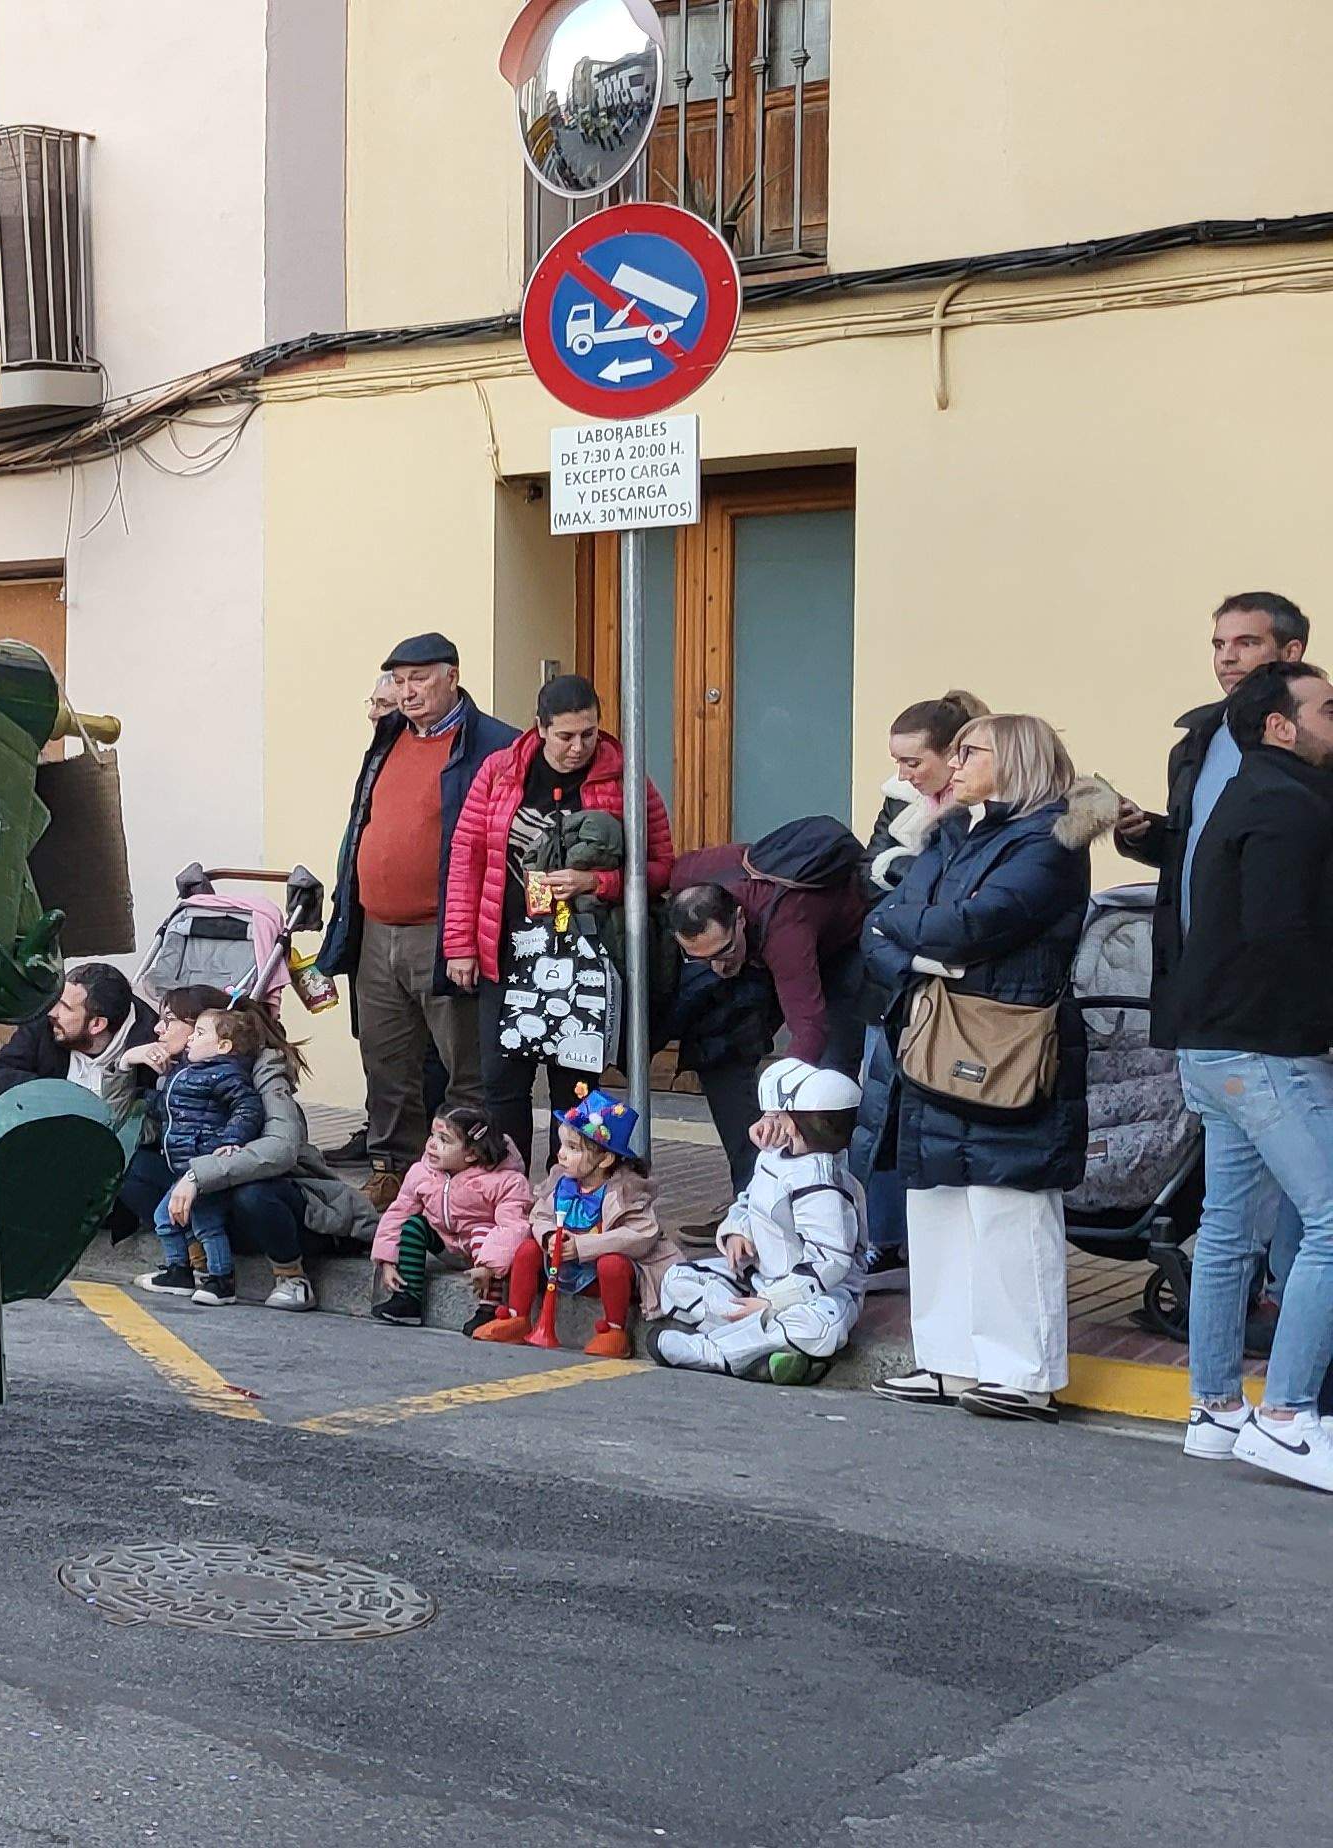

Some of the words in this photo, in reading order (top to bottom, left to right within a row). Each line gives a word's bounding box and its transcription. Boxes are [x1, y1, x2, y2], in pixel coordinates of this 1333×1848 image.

[577, 422, 667, 444] LABORABLES
[561, 452, 578, 466] DE
[583, 449, 611, 464] 7:30
[615, 447, 625, 461] A
[629, 443, 666, 459] 20:00
[670, 441, 685, 455] H.
[565, 467, 626, 486] EXCEPTO
[630, 462, 681, 480] CARGA
[578, 491, 586, 505] Y
[591, 484, 668, 503] DESCARGA
[554, 510, 596, 529] (MAX.
[600, 509, 616, 523] 30
[618, 501, 693, 522] MINUTOS)
